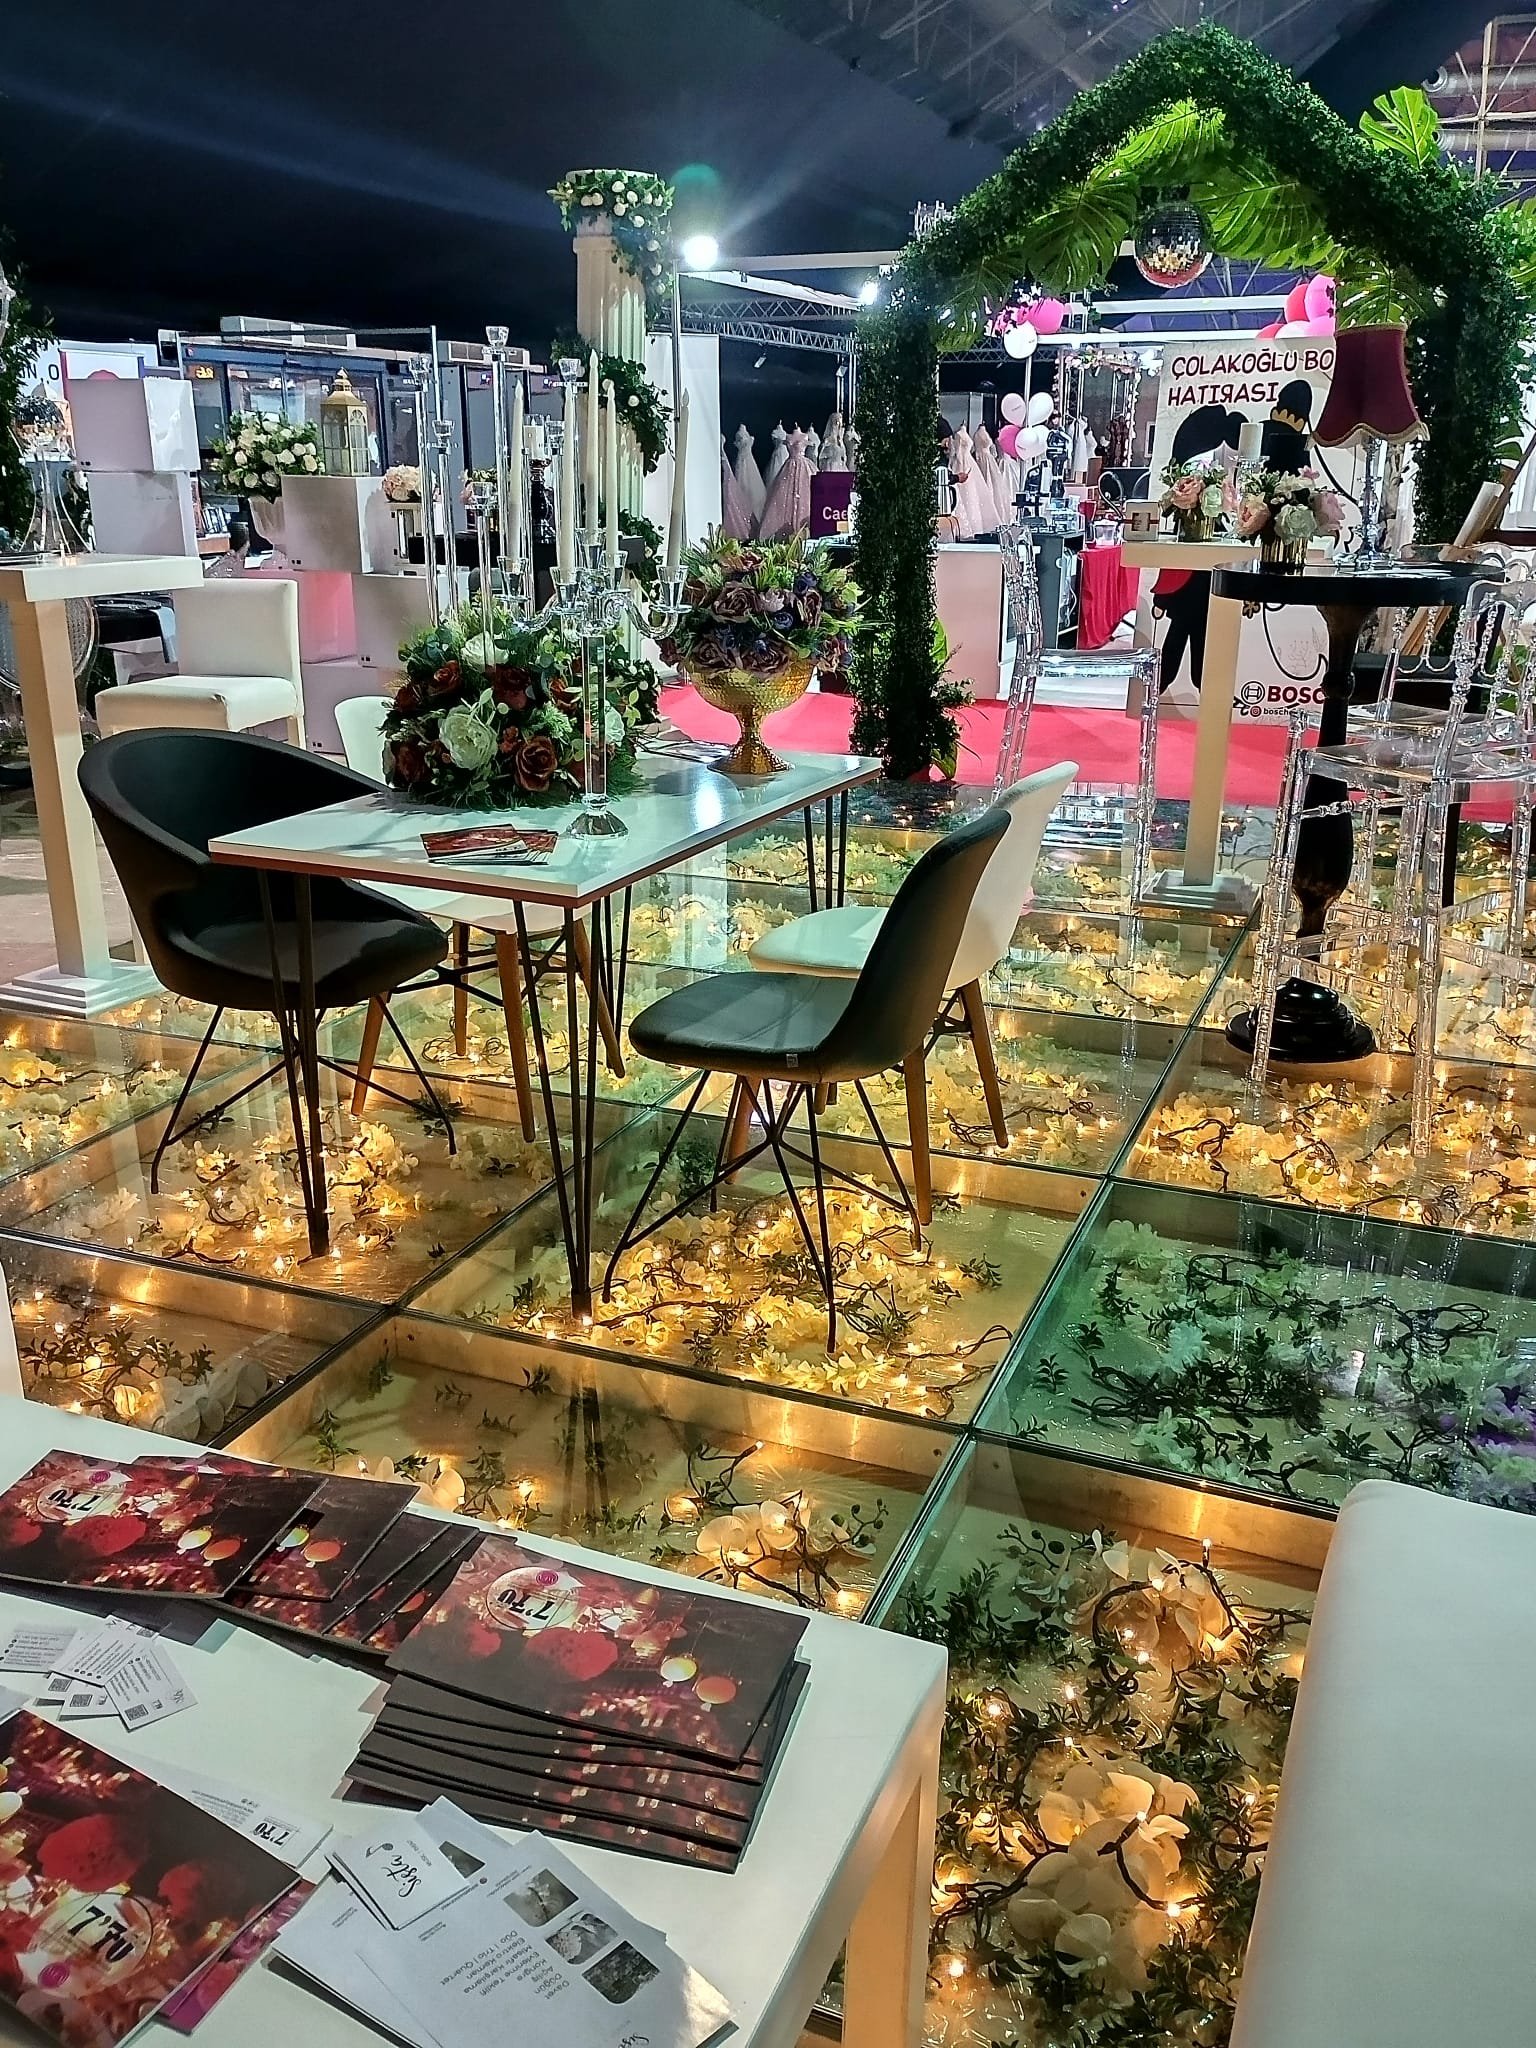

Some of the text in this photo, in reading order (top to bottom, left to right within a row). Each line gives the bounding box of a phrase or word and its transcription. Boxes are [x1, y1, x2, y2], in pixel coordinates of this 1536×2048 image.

[1171, 348, 1335, 380] ÇOLAKOĞLU BO
[822, 506, 848, 520] Cae
[1267, 685, 1326, 705] BOSC
